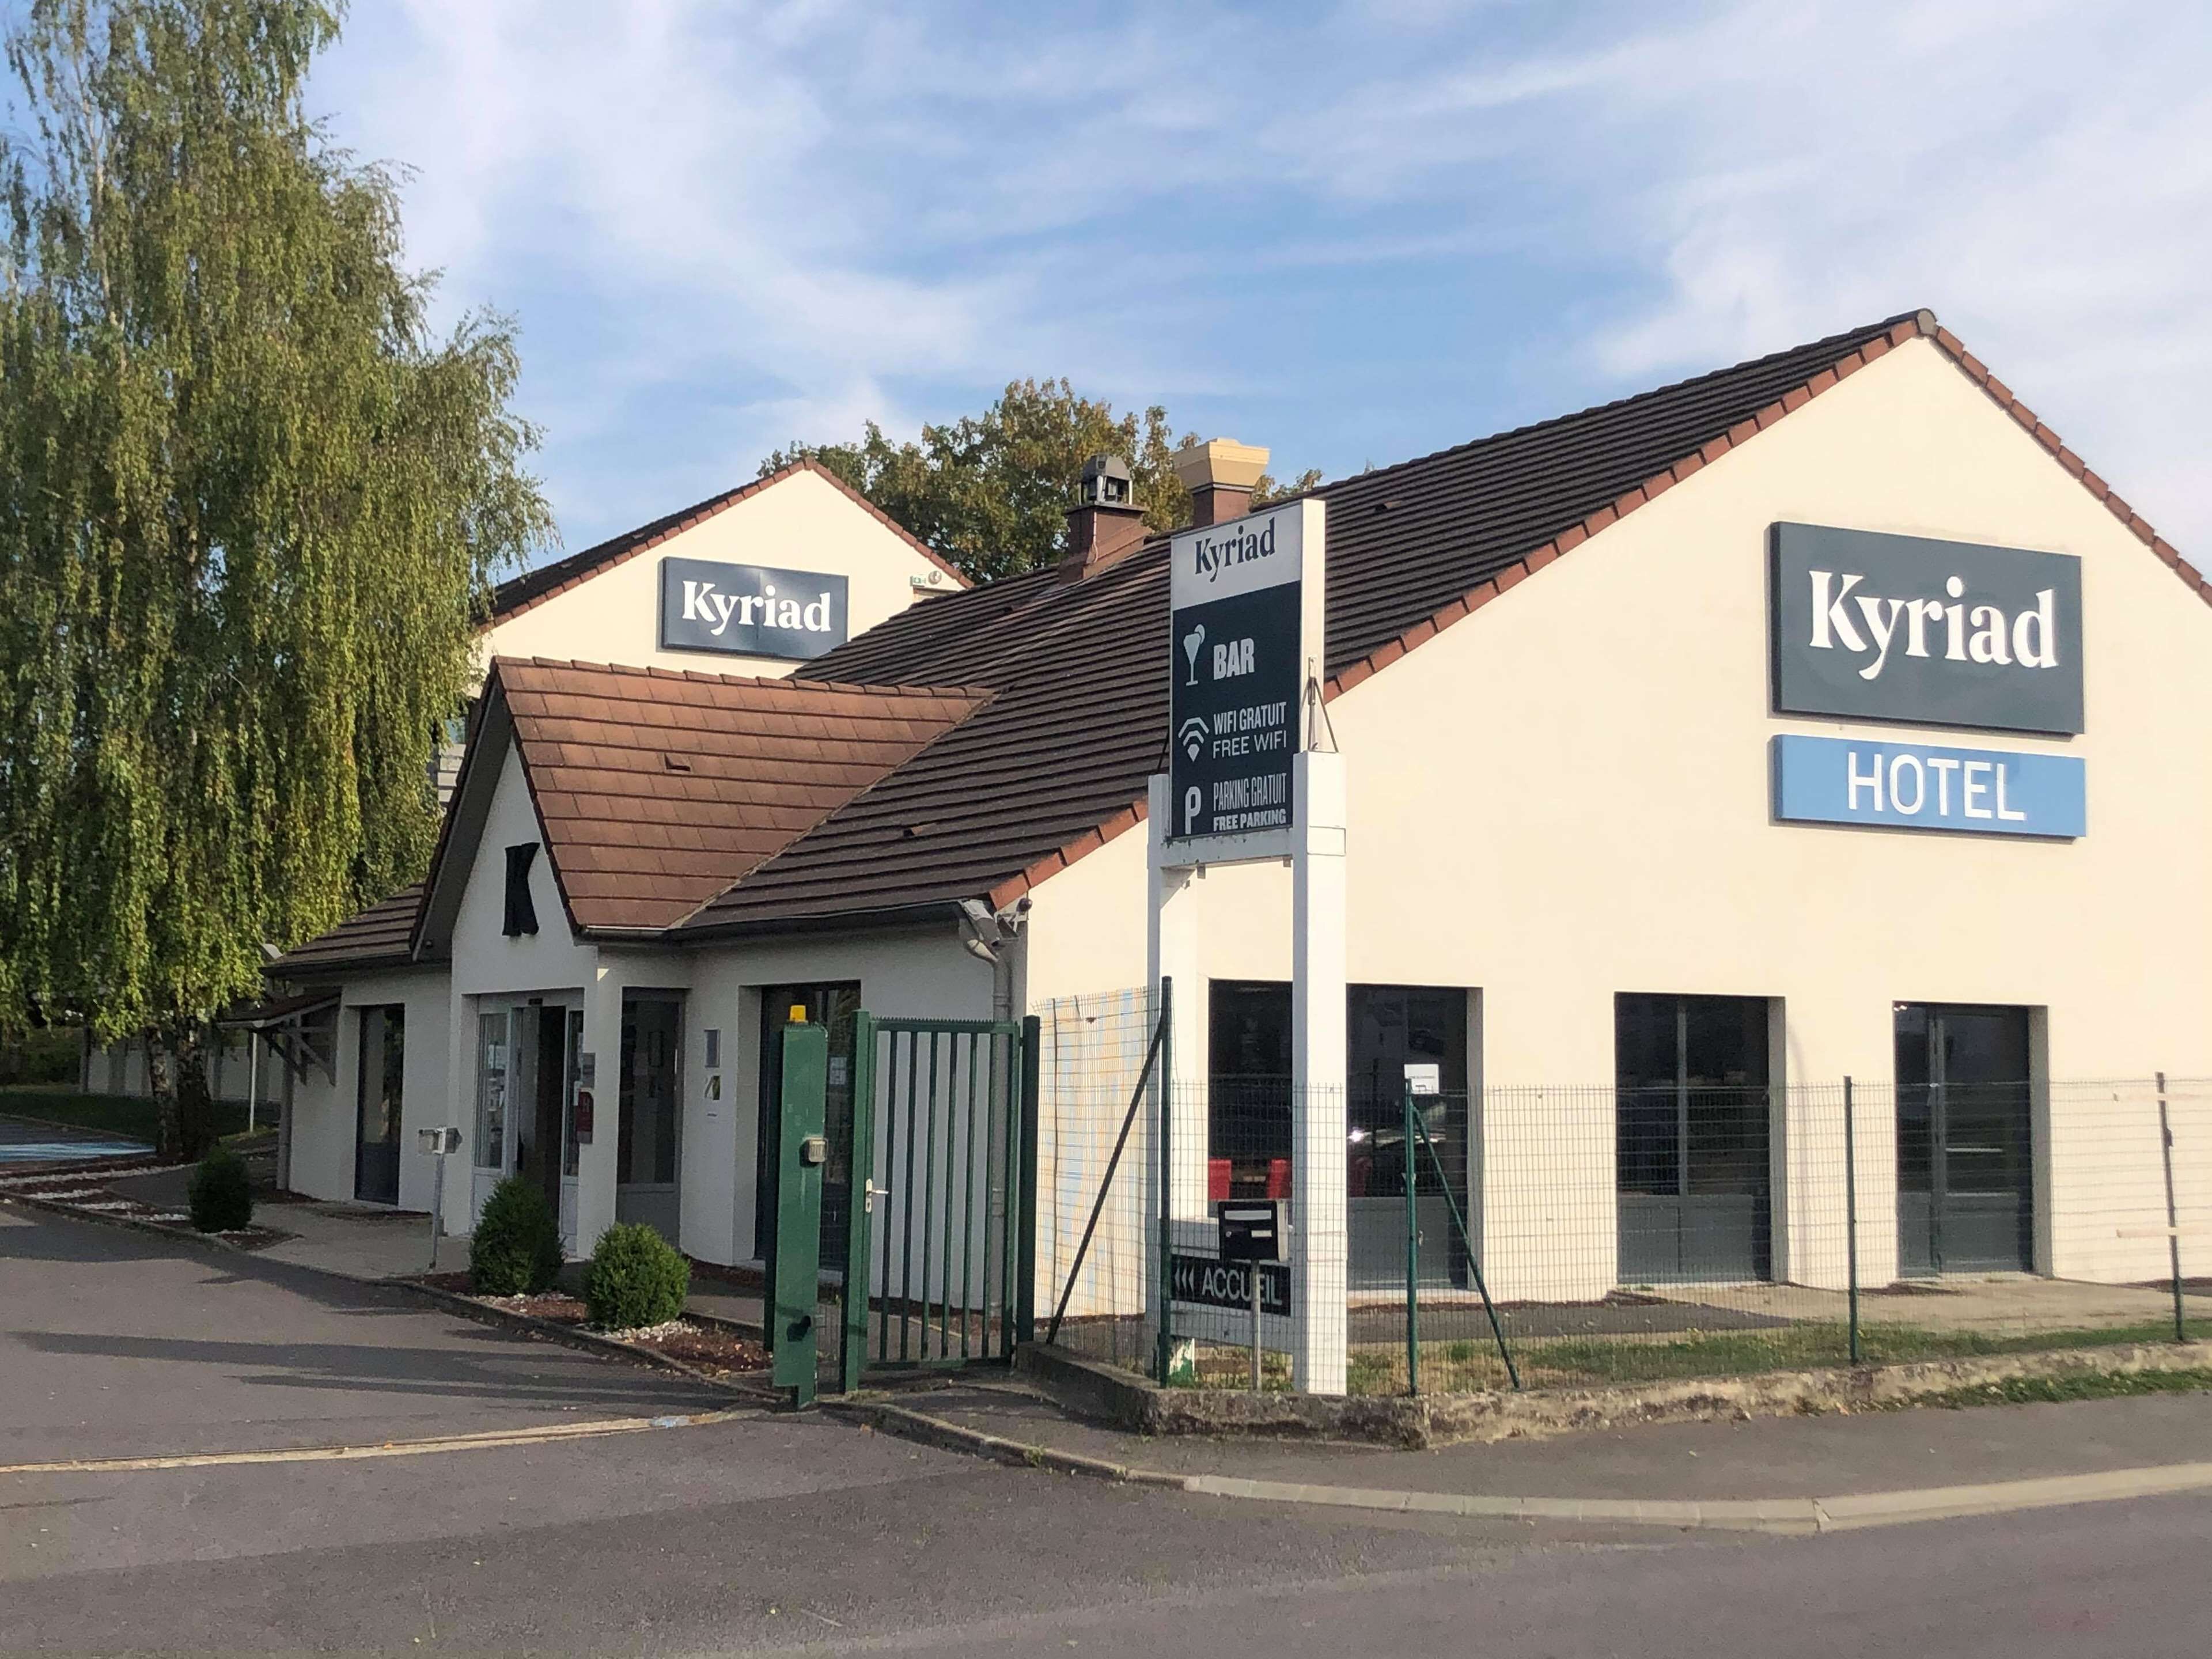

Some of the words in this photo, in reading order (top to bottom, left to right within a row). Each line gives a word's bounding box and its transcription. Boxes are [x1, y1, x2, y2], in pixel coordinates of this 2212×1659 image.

[1195, 517, 1276, 582] Kyriad
[682, 579, 831, 636] Kyriad
[1808, 570, 2059, 680] Kyriad
[1213, 638, 1255, 680] BAR
[1213, 710, 1237, 735] WIFI
[1239, 702, 1287, 731] GRATUIT
[1213, 736, 1250, 759] FREE
[1254, 730, 1287, 752] WIFI
[1213, 778, 1250, 812] PARKING
[1251, 772, 1287, 807] GRATUIT
[1847, 752, 2026, 821] HOTEL
[1213, 814, 1238, 832] FREE
[1240, 808, 1286, 828] PARKING
